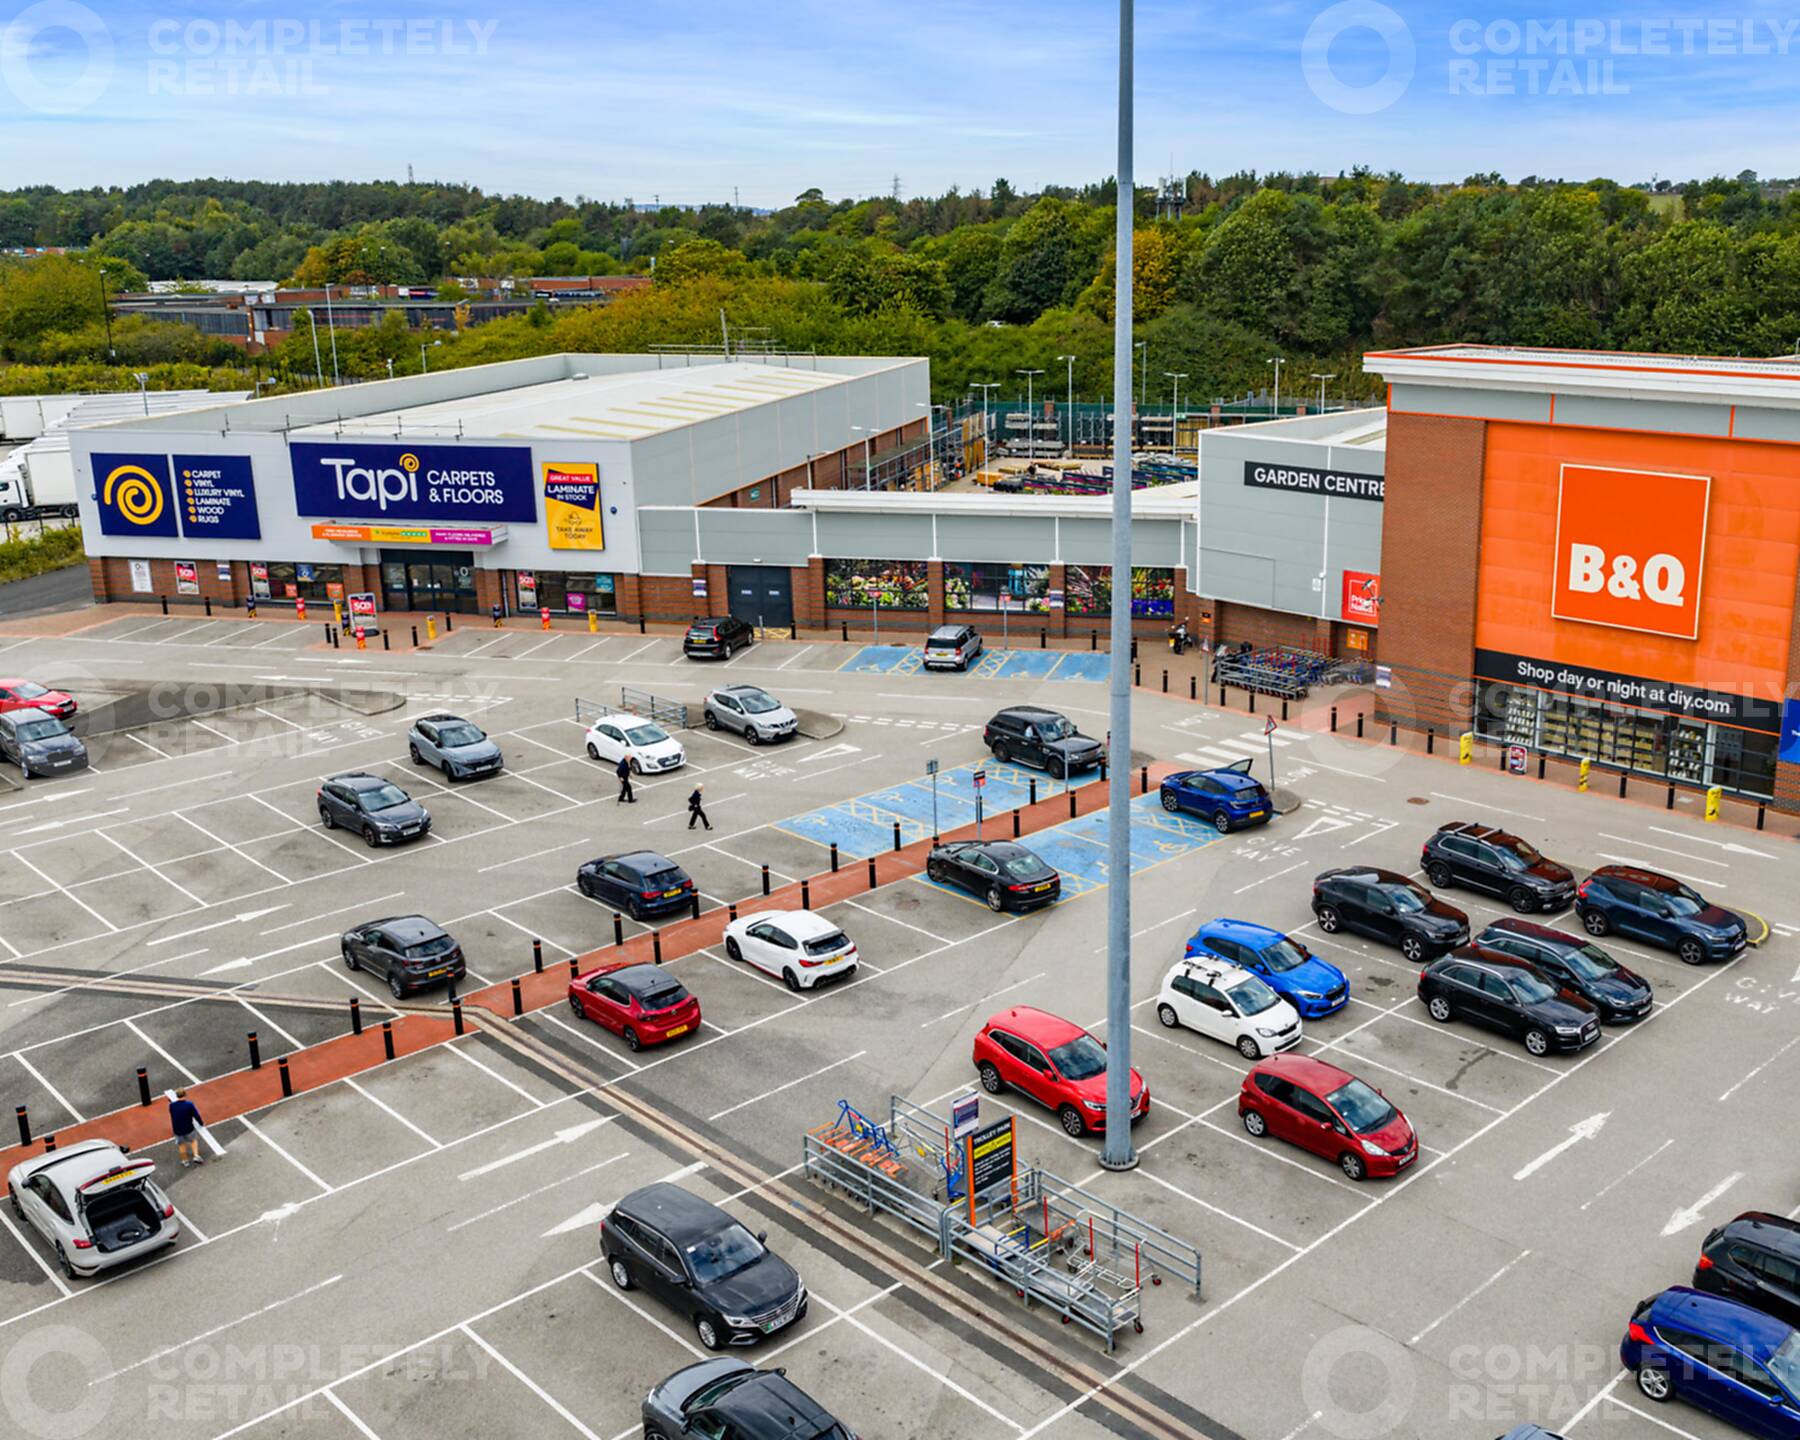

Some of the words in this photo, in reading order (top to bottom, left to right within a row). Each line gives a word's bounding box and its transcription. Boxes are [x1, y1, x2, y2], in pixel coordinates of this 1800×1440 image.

[191, 470, 222, 479] CARPET
[320, 453, 420, 511] Tapi
[426, 470, 496, 487] CARPETS
[549, 473, 570, 482] GREAT
[570, 475, 592, 483] VALUE
[1253, 467, 1321, 490] GARDEN
[428, 488, 442, 504] &
[443, 488, 504, 505] FLOORS
[547, 484, 595, 495] LAMINATE
[564, 494, 588, 502] STOCK
[196, 506, 225, 515] WOOD
[1568, 542, 1685, 607] B&Q
[1517, 660, 1555, 684] Shop
[1556, 670, 1585, 690] day
[1586, 674, 1606, 689] or
[1606, 679, 1647, 704] night
[1648, 686, 1667, 702] at
[1667, 689, 1731, 715] diy.com
